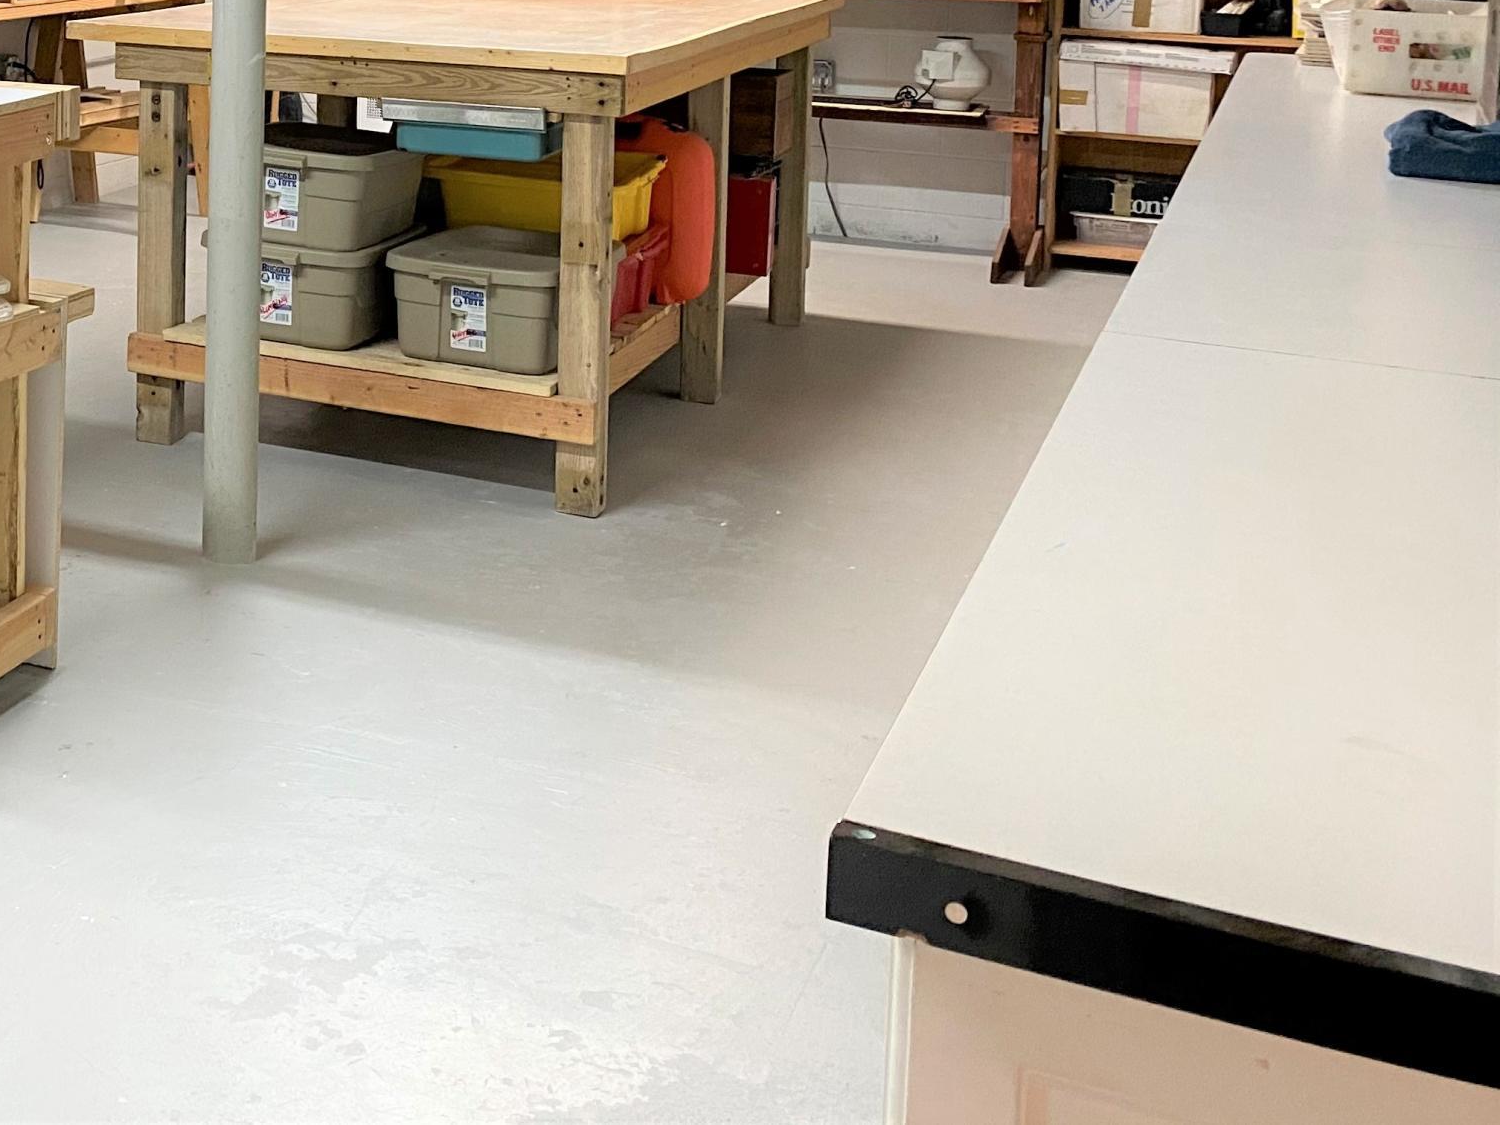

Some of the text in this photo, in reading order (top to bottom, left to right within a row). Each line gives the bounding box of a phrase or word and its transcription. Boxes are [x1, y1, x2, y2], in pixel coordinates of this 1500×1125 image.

[1411, 78, 1472, 95] U.S. MAIL
[268, 169, 297, 181] RUGGED
[278, 178, 297, 188] TOTE
[262, 263, 291, 275] RUGGED
[271, 272, 290, 282] TOTE
